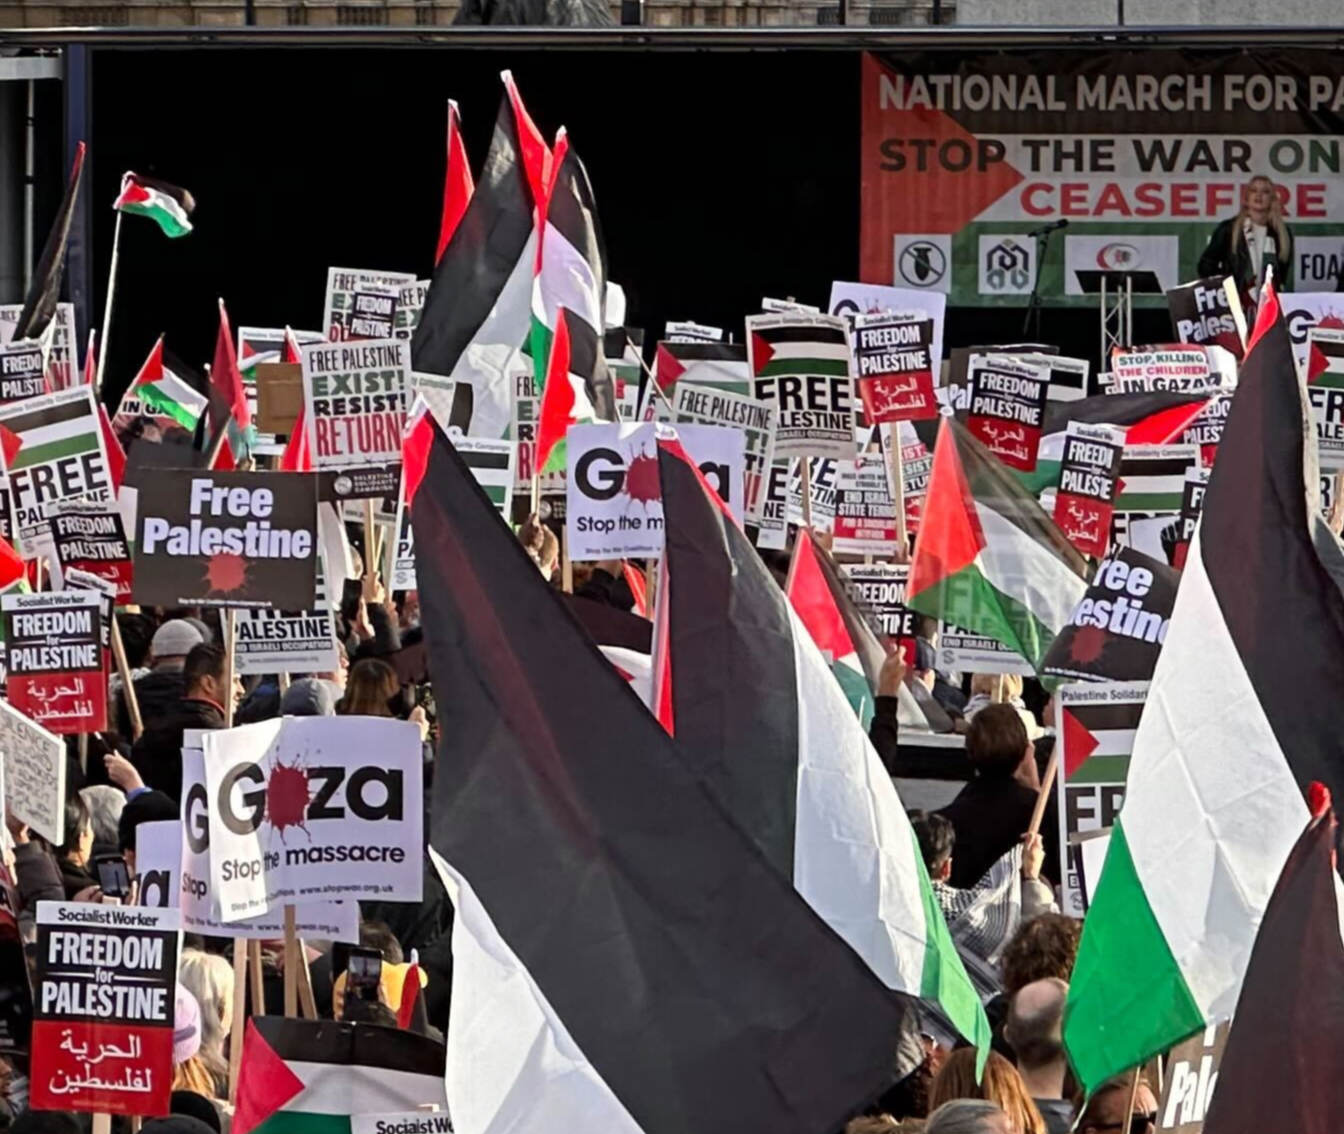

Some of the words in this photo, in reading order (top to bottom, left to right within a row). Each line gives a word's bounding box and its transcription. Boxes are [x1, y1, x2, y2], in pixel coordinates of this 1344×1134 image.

[879, 74, 1058, 112] NATIONAL
[1073, 75, 1213, 112] MARCH
[1224, 75, 1297, 112] FOR
[879, 138, 1006, 172] STOP
[1022, 139, 1116, 173] THE
[1132, 139, 1253, 174] WAR
[1268, 139, 1342, 174] ON
[1300, 253, 1338, 280] FOA
[861, 325, 921, 348] FREEDOM
[310, 348, 338, 373] FREE
[342, 345, 403, 371] PALESTINE
[860, 351, 928, 375] PALESTINE
[1118, 367, 1142, 377] THE
[1146, 366, 1206, 376] CHILDREN
[1156, 353, 1204, 364] KILLING
[311, 370, 405, 397] EXIST!
[754, 377, 851, 412] FREE
[312, 394, 406, 416] RESIST!
[190, 478, 274, 516] Free
[143, 517, 313, 560] Palestine
[577, 514, 613, 536] Stop
[618, 514, 649, 533] the
[12, 610, 92, 636] FREEDOM
[10, 638, 99, 670] PALESTINE
[217, 760, 404, 837] Gza
[221, 857, 262, 883] Stop
[263, 851, 280, 872] the
[285, 844, 406, 867] massacre
[48, 930, 163, 970] FREEDOM
[95, 966, 115, 984] for
[41, 981, 167, 1021] PALESTINE
